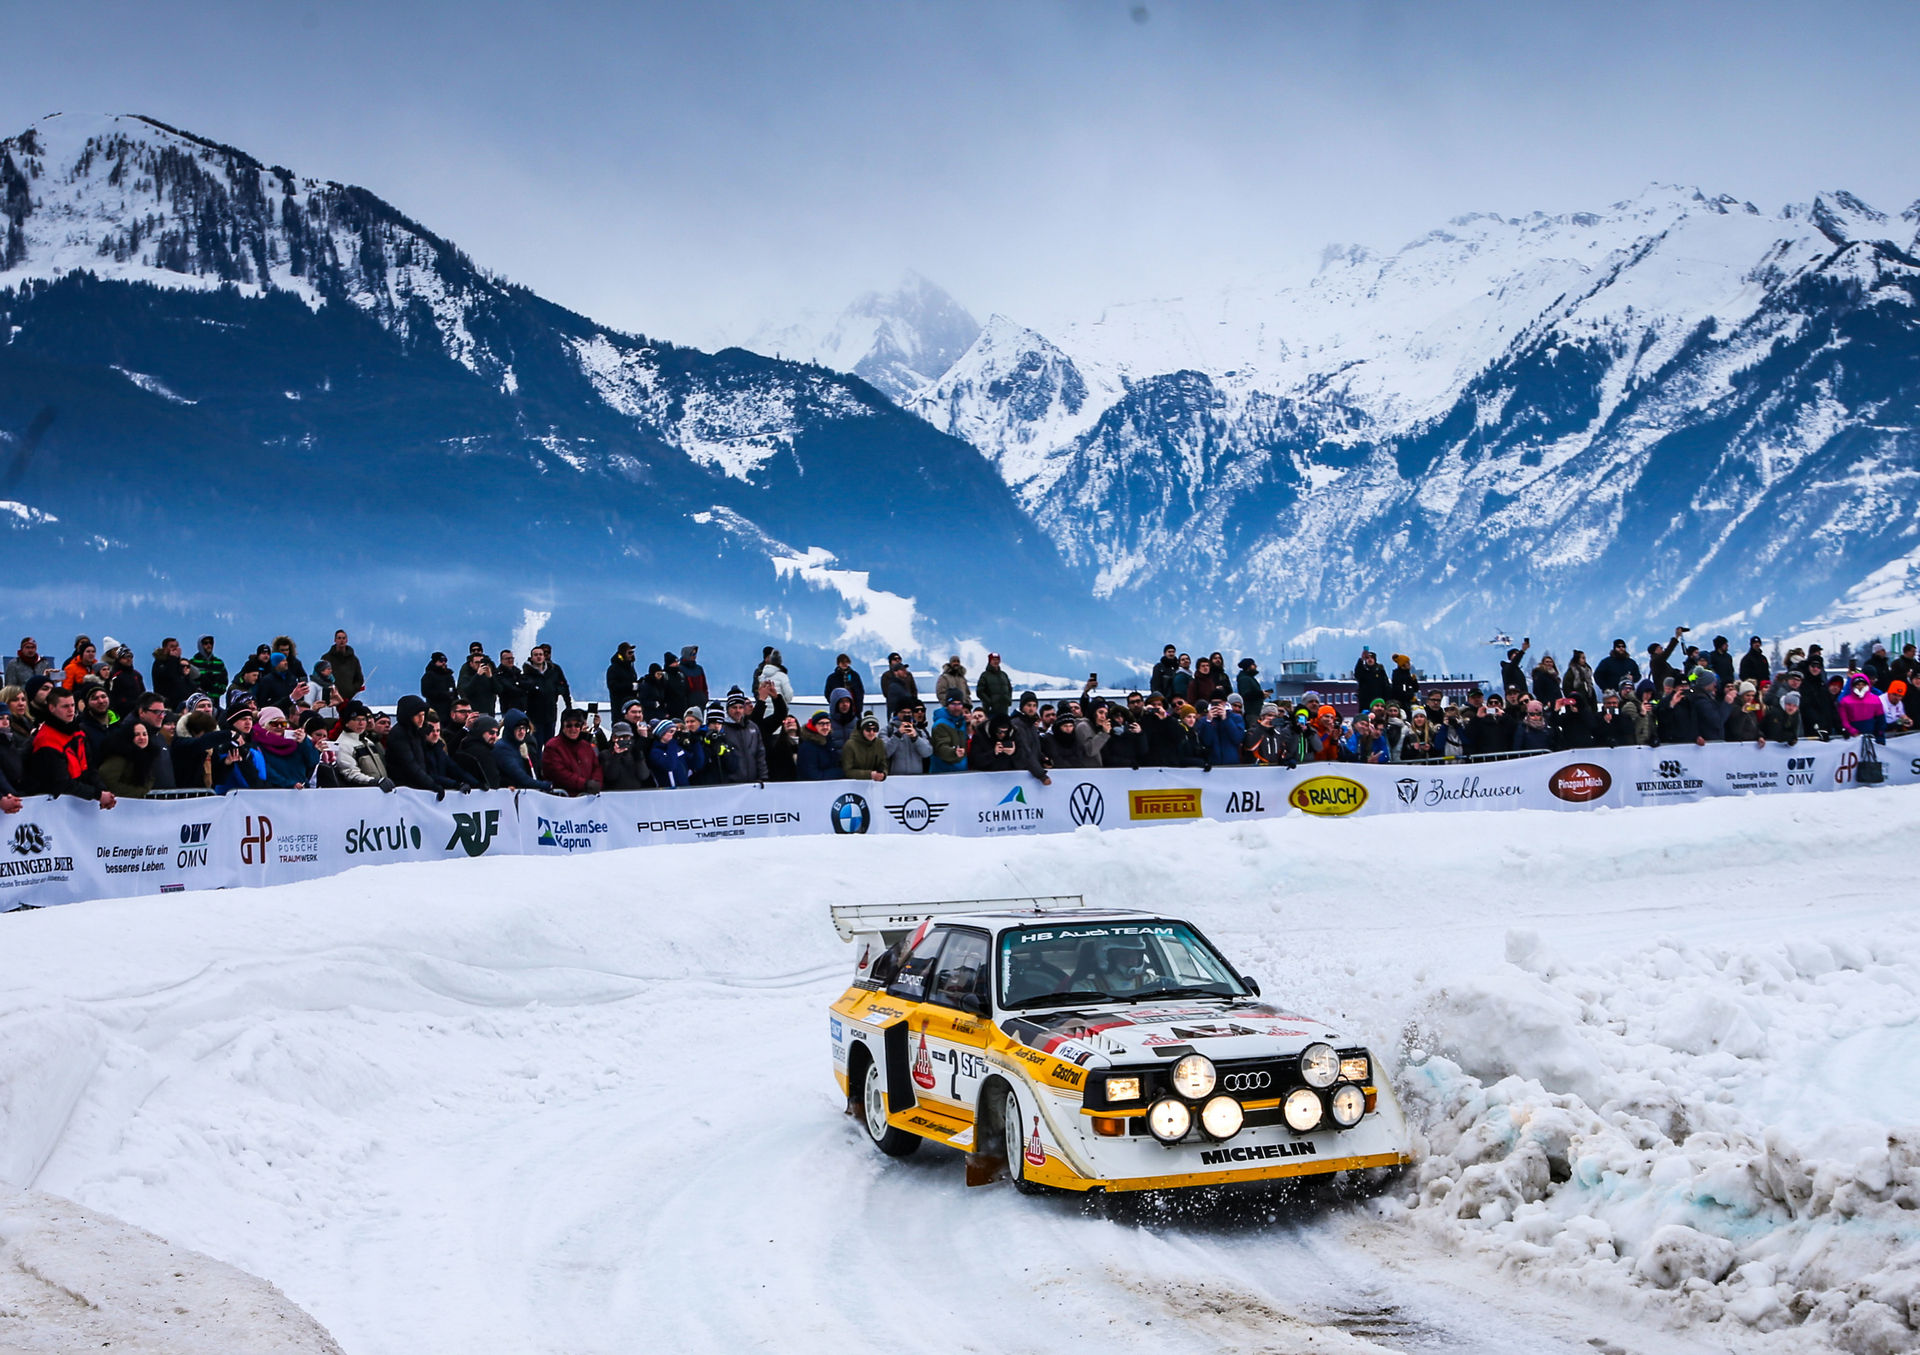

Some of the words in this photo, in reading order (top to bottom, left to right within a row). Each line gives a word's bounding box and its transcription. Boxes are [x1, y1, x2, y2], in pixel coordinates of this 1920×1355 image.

[1558, 779, 1584, 791] Pinzgau
[1585, 777, 1603, 787] Milch
[1737, 772, 1758, 780] Energie
[1786, 773, 1815, 786] OMV
[1424, 776, 1525, 806] Backhausen
[1635, 780, 1683, 791] WIENINGER
[1683, 780, 1704, 789] BIER
[1135, 794, 1196, 814] PIRELLI
[1226, 791, 1265, 813] ABL
[1308, 787, 1357, 806] RAUCH
[637, 816, 728, 832] PORSCHE
[732, 811, 801, 826] DESIGN
[906, 809, 927, 819] MINI
[978, 808, 1044, 823] SCHMITTEN
[445, 809, 501, 857] RUF
[552, 820, 574, 834] Zell
[574, 824, 587, 834] am
[588, 820, 608, 834] See
[695, 829, 745, 838] TIMEPIECES
[277, 834, 318, 844] HANS-PETER
[555, 834, 592, 852] Kaprun
[97, 846, 110, 858] Die
[112, 846, 143, 860] Energie
[145, 845, 156, 857] für
[157, 846, 169, 856] ein
[278, 843, 318, 852] PORSCHE
[177, 848, 208, 869] OMV
[279, 854, 318, 863] TRAUMWERK
[105, 863, 139, 874] besseres
[141, 861, 166, 872] Leben.
[1021, 932, 1053, 944] HB
[1111, 927, 1174, 936] TEAM
[962, 1053, 977, 1078] S1
[1026, 1051, 1046, 1066] Sport
[949, 1049, 962, 1100] 2
[1052, 1063, 1083, 1086] Castrol
[1030, 1136, 1041, 1155] HB
[1200, 1141, 1317, 1165] MICHELIN
